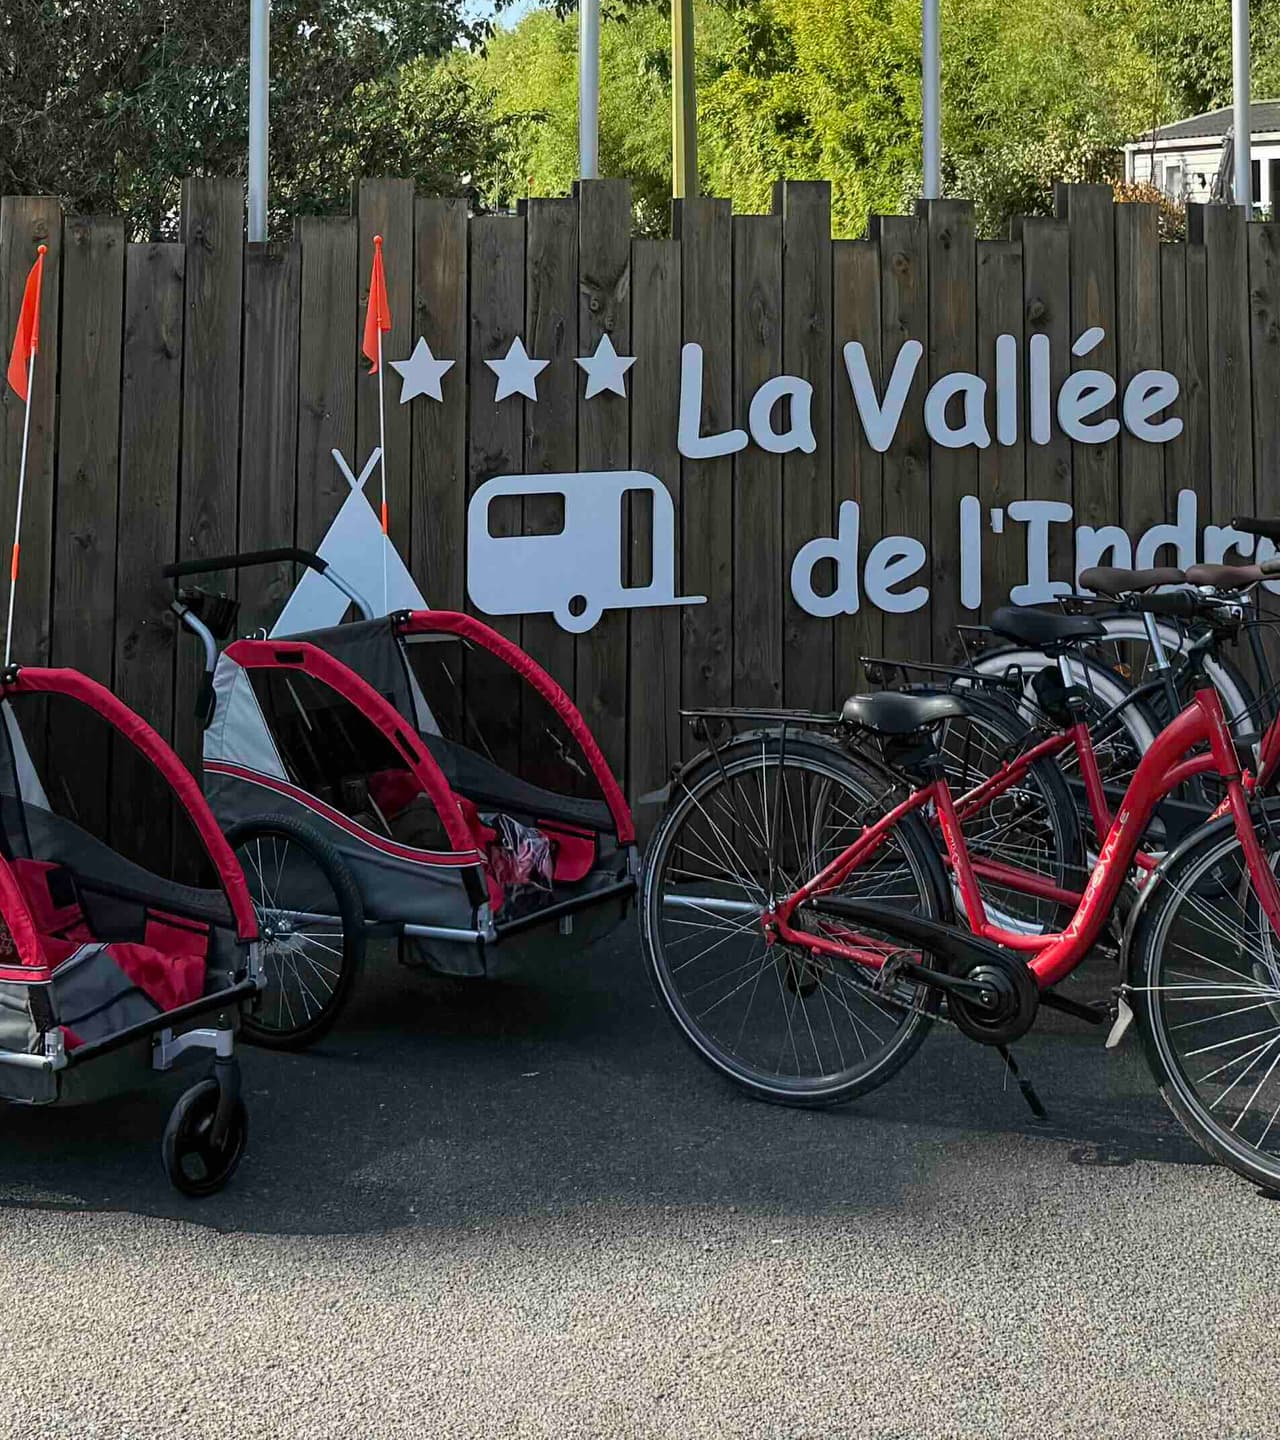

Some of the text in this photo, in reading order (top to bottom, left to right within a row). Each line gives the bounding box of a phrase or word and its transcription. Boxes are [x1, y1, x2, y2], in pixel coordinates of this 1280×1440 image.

[678, 327, 1184, 459] La Vallée
[791, 500, 929, 617] de
